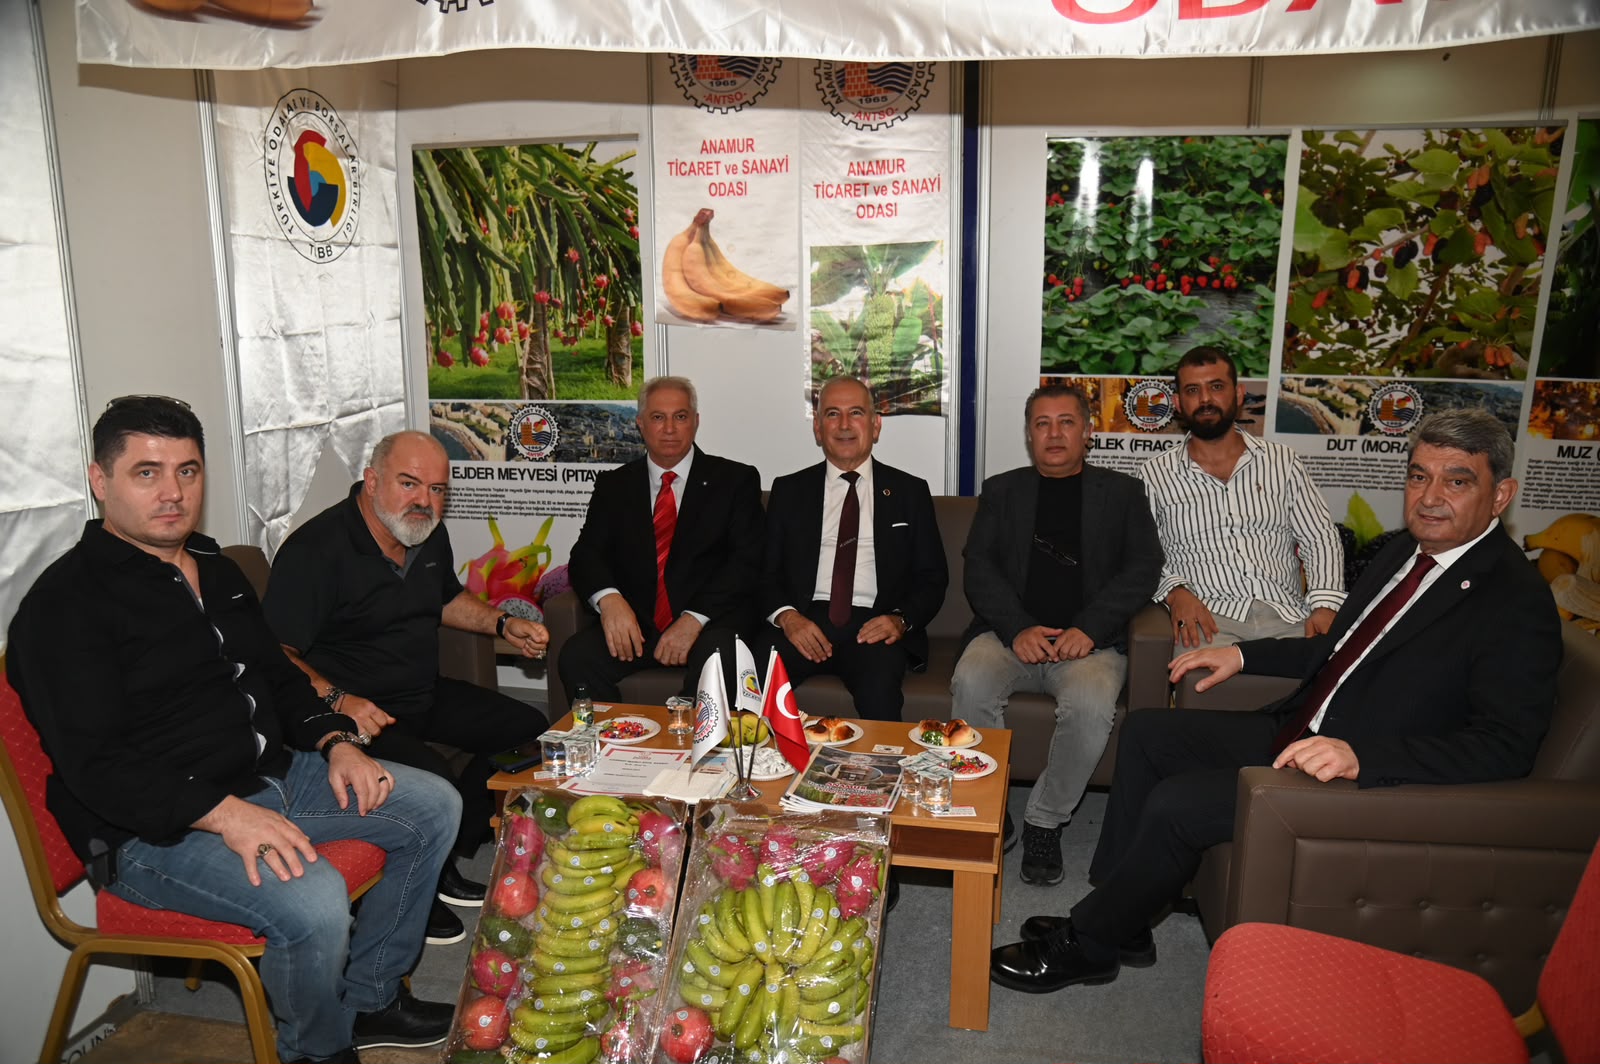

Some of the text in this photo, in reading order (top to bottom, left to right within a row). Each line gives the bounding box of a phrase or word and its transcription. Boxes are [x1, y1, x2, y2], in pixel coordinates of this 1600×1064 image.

[710, 79, 737, 87] 1965
[859, 95, 888, 104] 1965
[700, 138, 755, 154] ANAMUR
[667, 154, 789, 176] TİCARET ve SANAYİ
[847, 158, 906, 177] ANAMUR
[708, 181, 747, 197] ODASI
[813, 173, 941, 199] TİCARET ve SANAYİ
[856, 202, 898, 219] ODASI
[309, 243, 333, 259] TBB
[1085, 435, 1182, 453] ÇİLEK (FRAG
[1326, 438, 1357, 451] DUT
[1557, 445, 1593, 459] MUZ
[452, 466, 494, 480] EJDER
[498, 465, 557, 481] MEYVESİ
